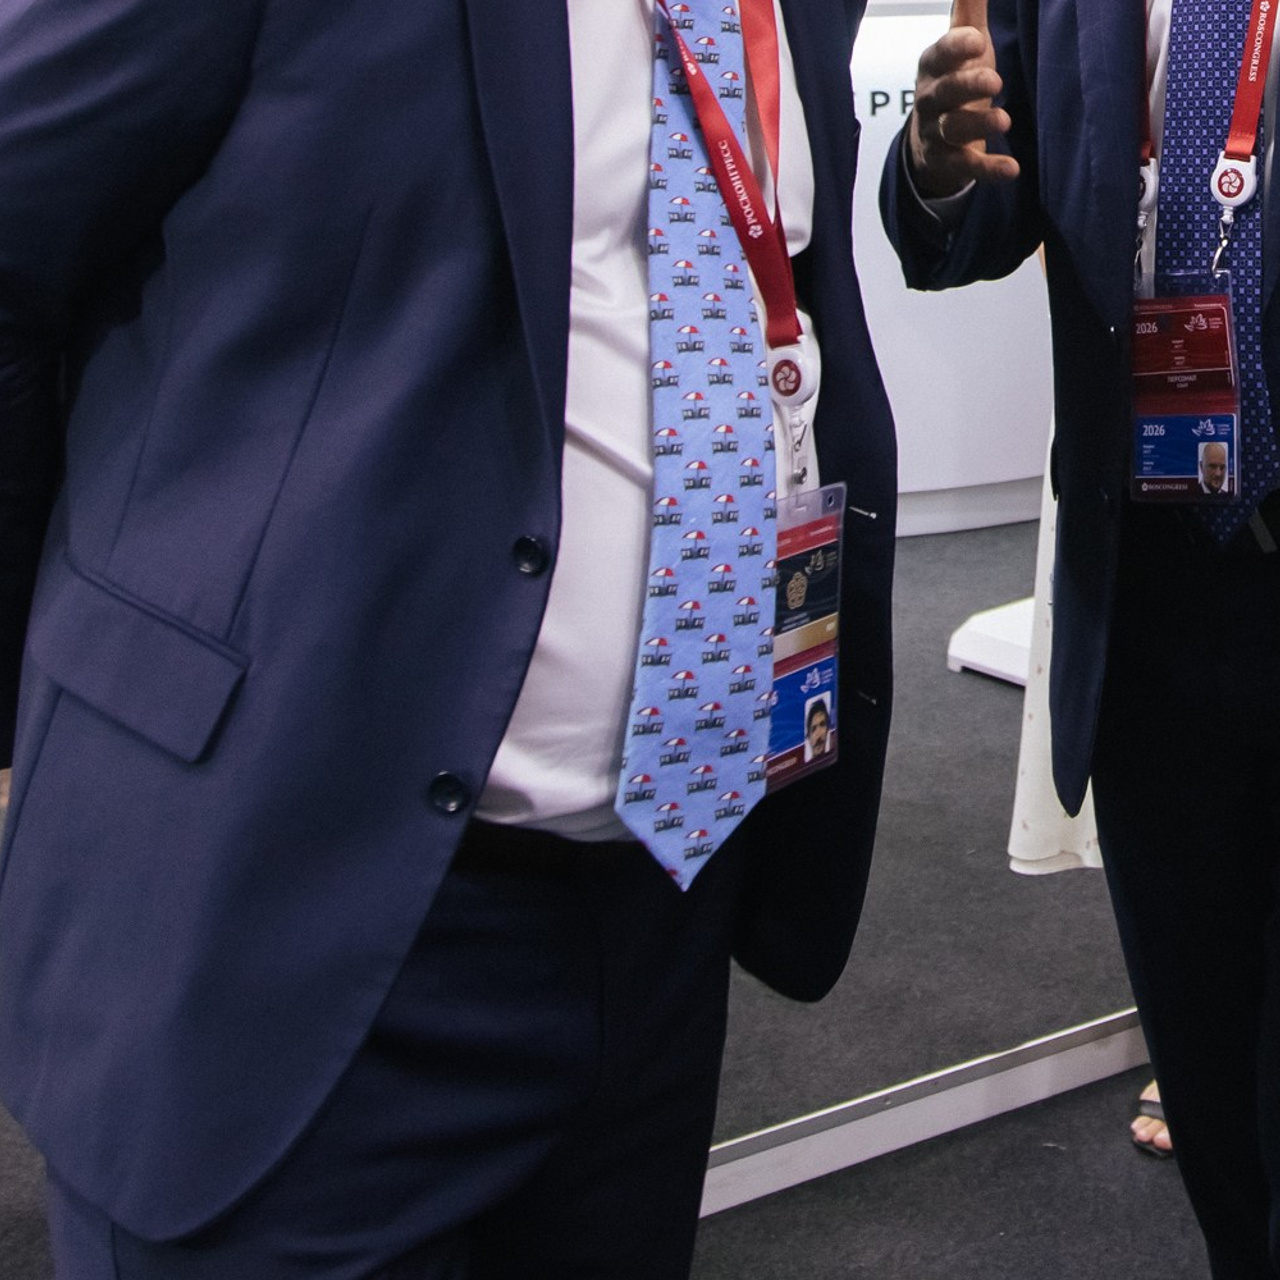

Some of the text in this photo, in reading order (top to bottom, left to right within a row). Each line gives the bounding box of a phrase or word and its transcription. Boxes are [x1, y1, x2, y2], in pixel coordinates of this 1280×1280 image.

[1248, 12, 1268, 82] ROSCONGRESS
[717, 139, 760, 227] РОСКОНГРЕСС
[1135, 322, 1158, 334] 2026
[1142, 424, 1165, 436] 2026
